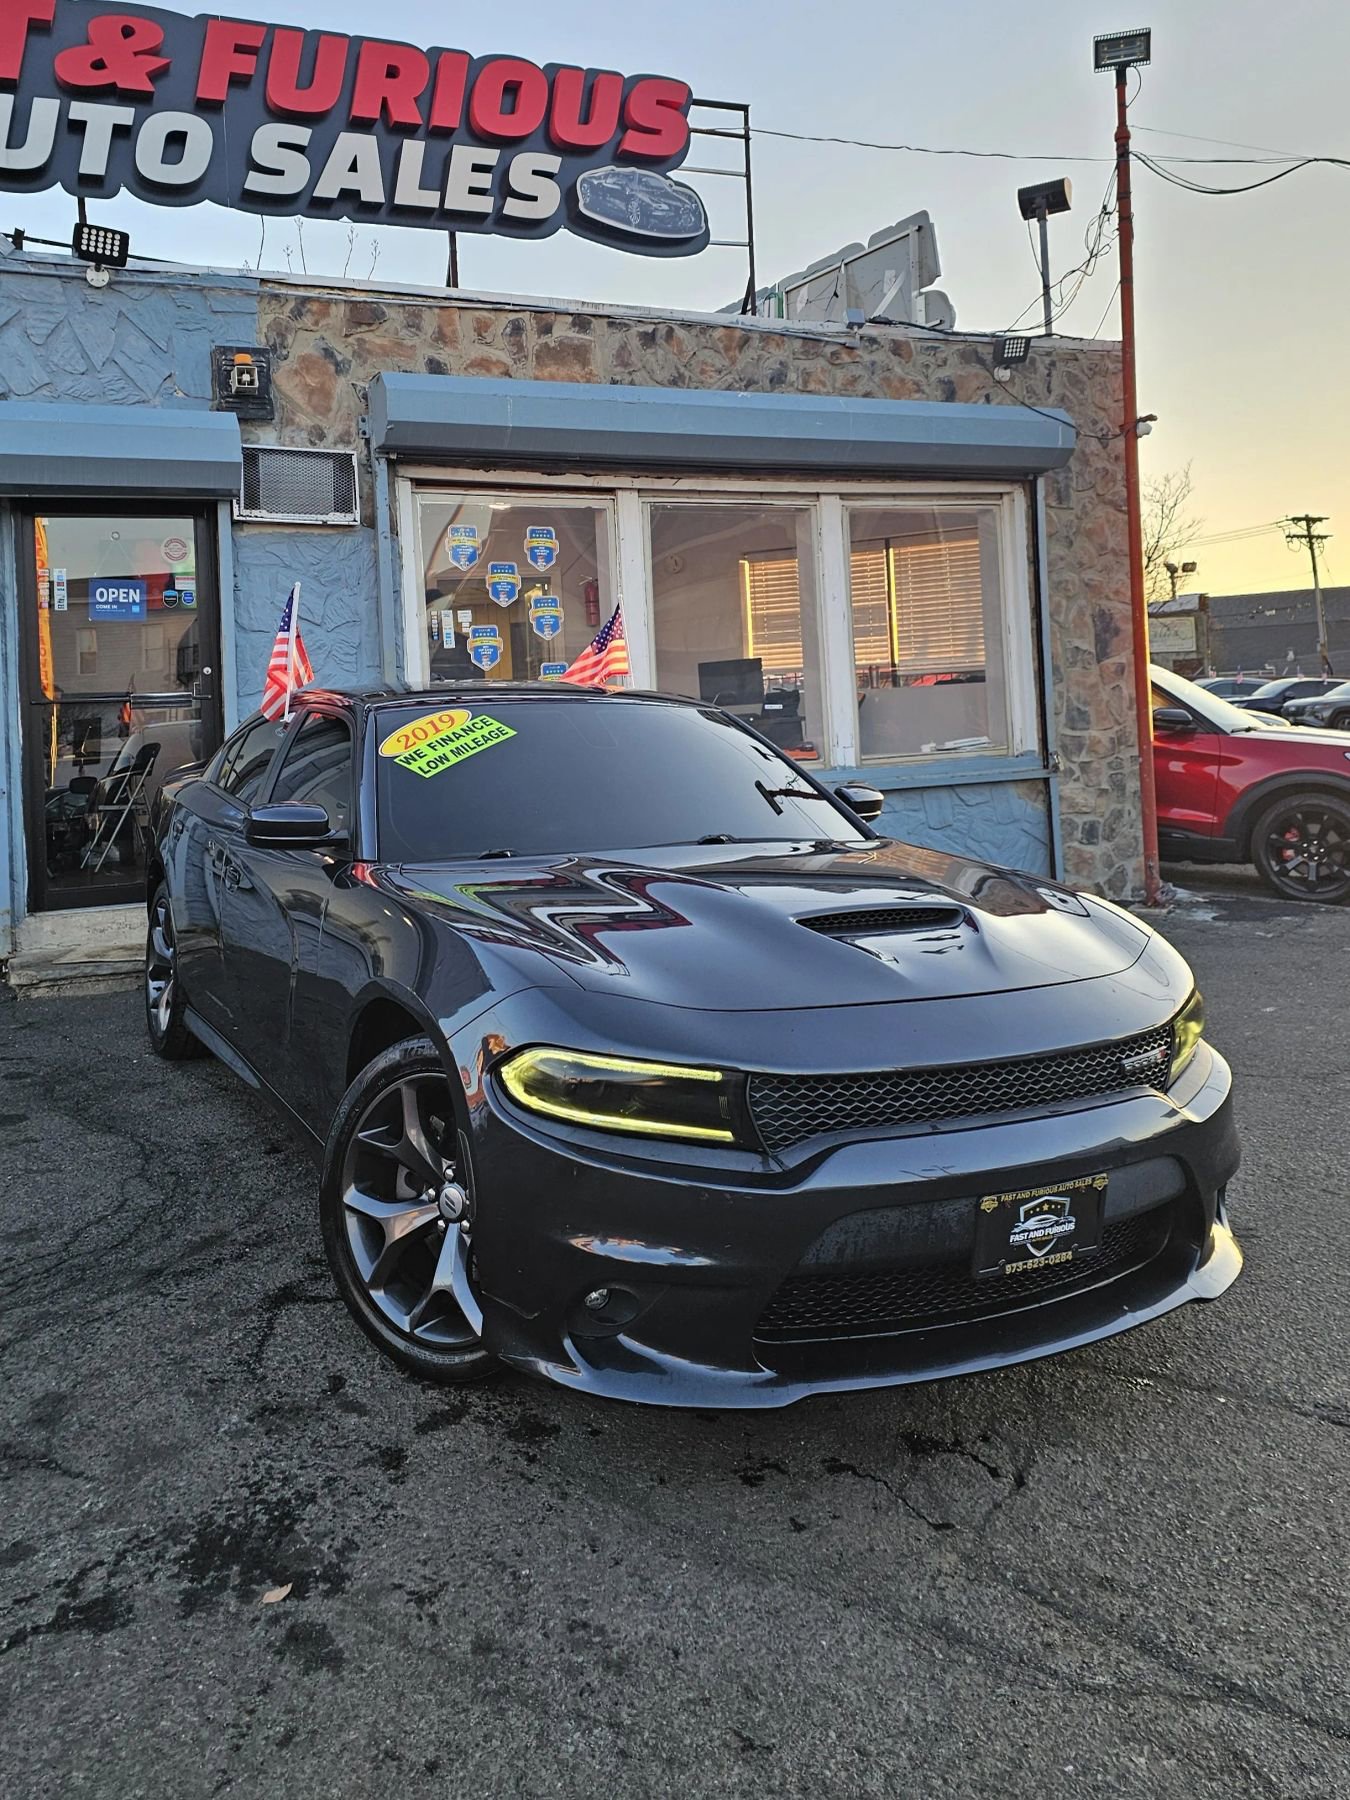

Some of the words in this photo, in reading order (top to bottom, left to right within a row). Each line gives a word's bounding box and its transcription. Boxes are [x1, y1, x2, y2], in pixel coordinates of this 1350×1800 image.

[54, 15, 172, 94] &
[196, 19, 690, 158] FURIOUS
[0, 94, 213, 185] UTO
[244, 123, 562, 220] SALES
[95, 587, 140, 603] OPEN
[396, 713, 456, 750] 2019
[399, 748, 427, 766] WE
[426, 717, 494, 751] FINANCE
[418, 753, 450, 775] LOW
[449, 726, 509, 758] MILEAGE
[1001, 1193, 1016, 1202] FAST
[1016, 1190, 1031, 1199] AND
[1031, 1186, 1058, 1197] FURIOUS
[1058, 1182, 1074, 1192] AUTO
[1009, 1233, 1029, 1243] FAST
[1028, 1229, 1045, 1239] AND
[1045, 1222, 1076, 1236] FURIOUS
